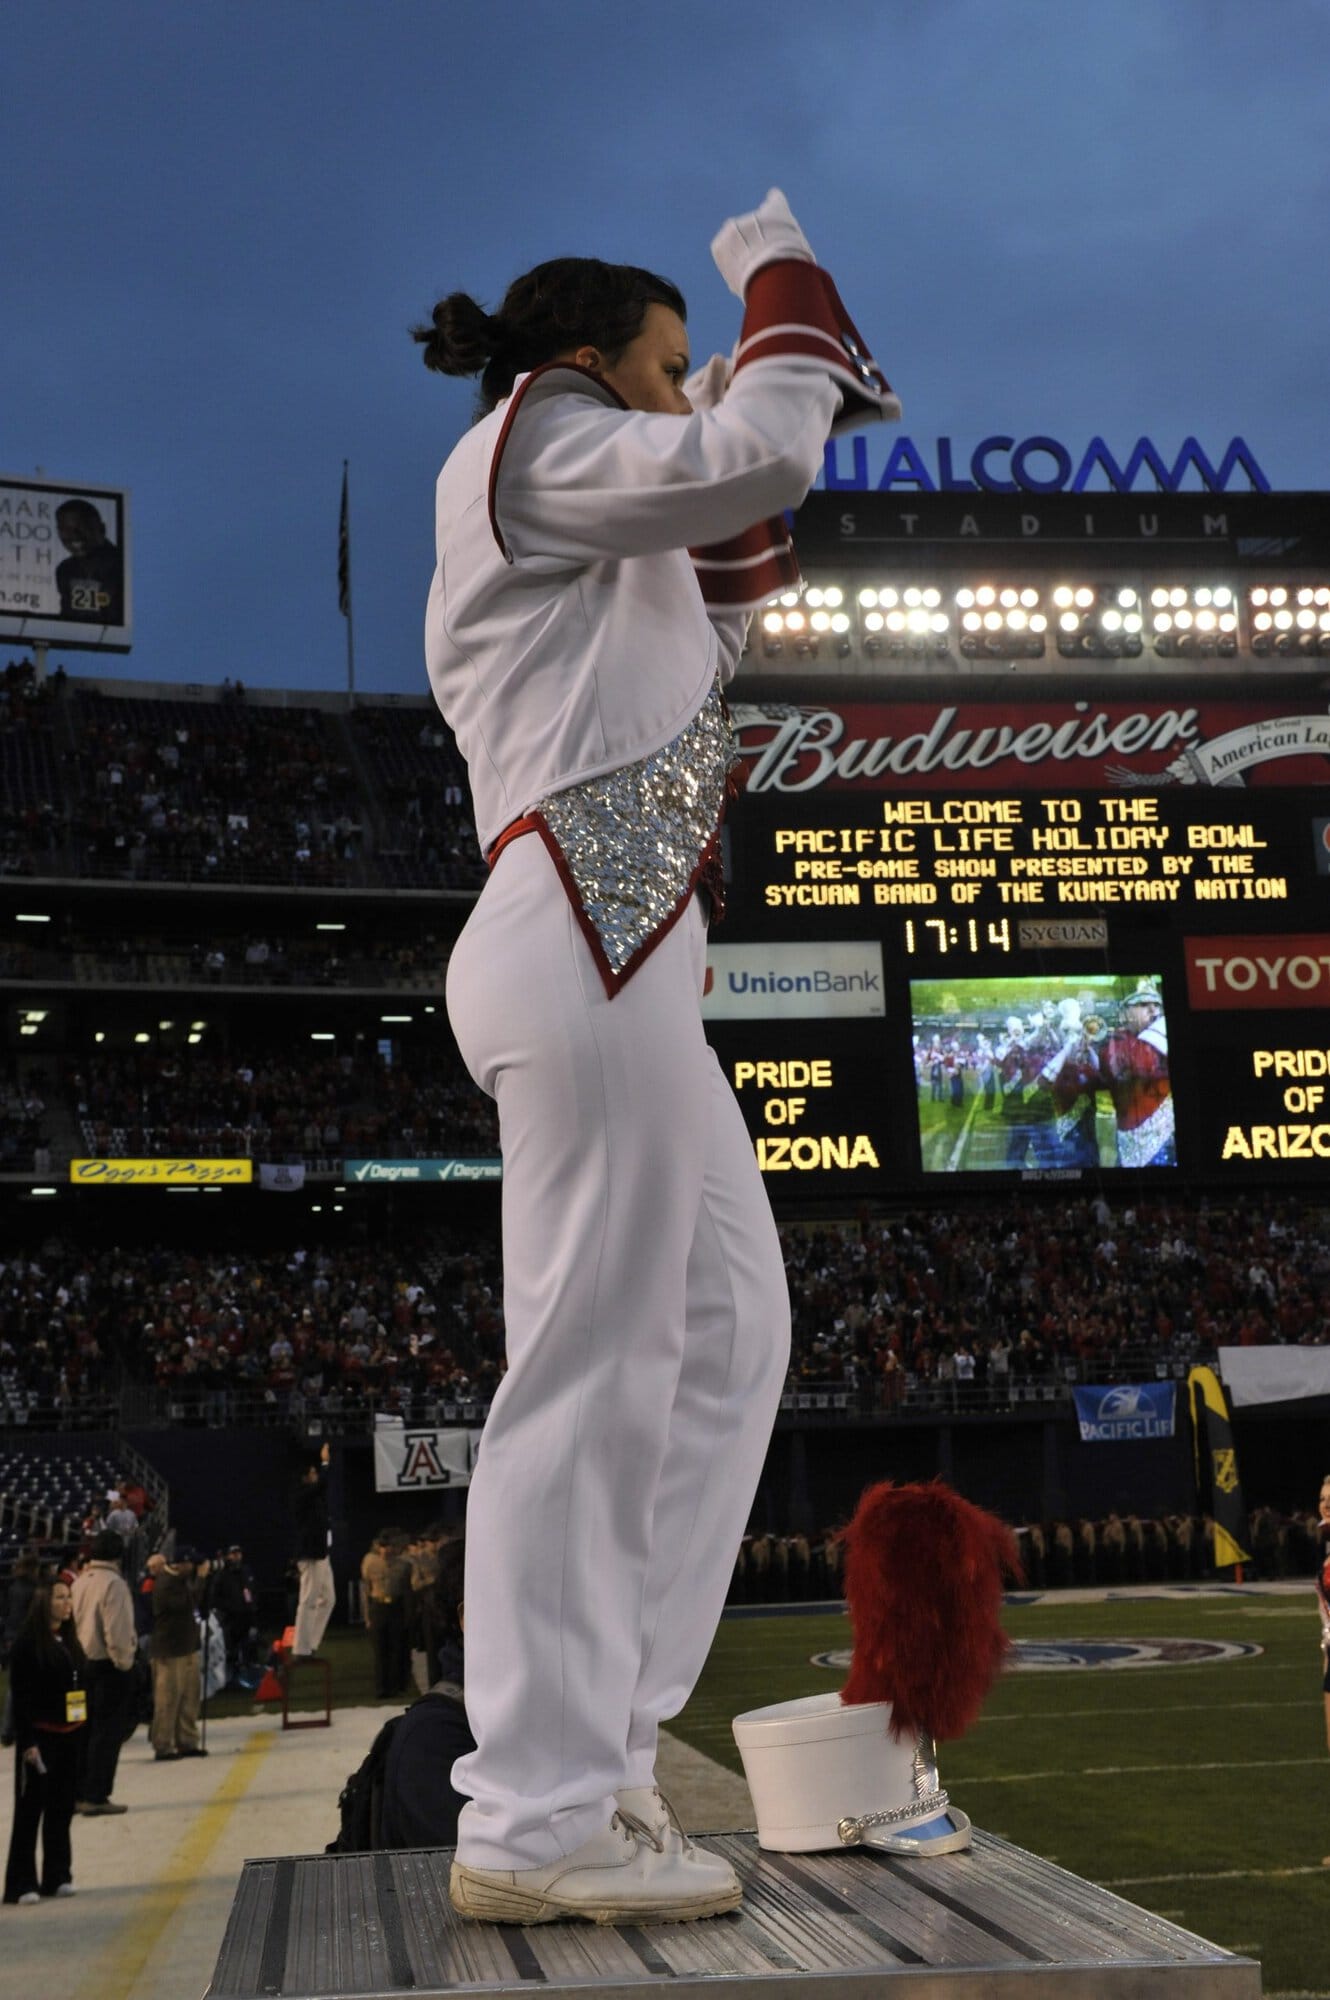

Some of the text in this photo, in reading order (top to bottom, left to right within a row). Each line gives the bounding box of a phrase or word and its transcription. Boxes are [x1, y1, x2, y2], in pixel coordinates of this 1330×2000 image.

[824, 436, 1271, 493] UALCOMM
[840, 514, 1228, 537] STADIUM
[735, 701, 1199, 793] Budweiser
[1210, 726, 1330, 774] American La
[884, 798, 1158, 824] WELCOME TO THE
[775, 825, 1267, 853] PACIFIC LIFE HOLIDAY BOWL
[795, 855, 1255, 879] PRE-GAME SHOW PRESENTED BY THE
[765, 879, 1288, 905] SYCUAN BAND OF THE KUMEYAAY NATION
[905, 918, 1010, 953] 17:14
[1020, 926, 1106, 942] SYCUAN
[729, 970, 879, 993] UnionBank
[735, 1060, 832, 1089] PRIDE
[1253, 1050, 1330, 1077] PRID
[764, 1098, 806, 1125] OF
[1284, 1086, 1325, 1113] OF
[757, 1135, 880, 1170] IZONA
[370, 1164, 420, 1180] Degree
[453, 1163, 502, 1179] Degree
[1081, 1422, 1143, 1440] PACIFIC
[397, 1433, 450, 1486] A
